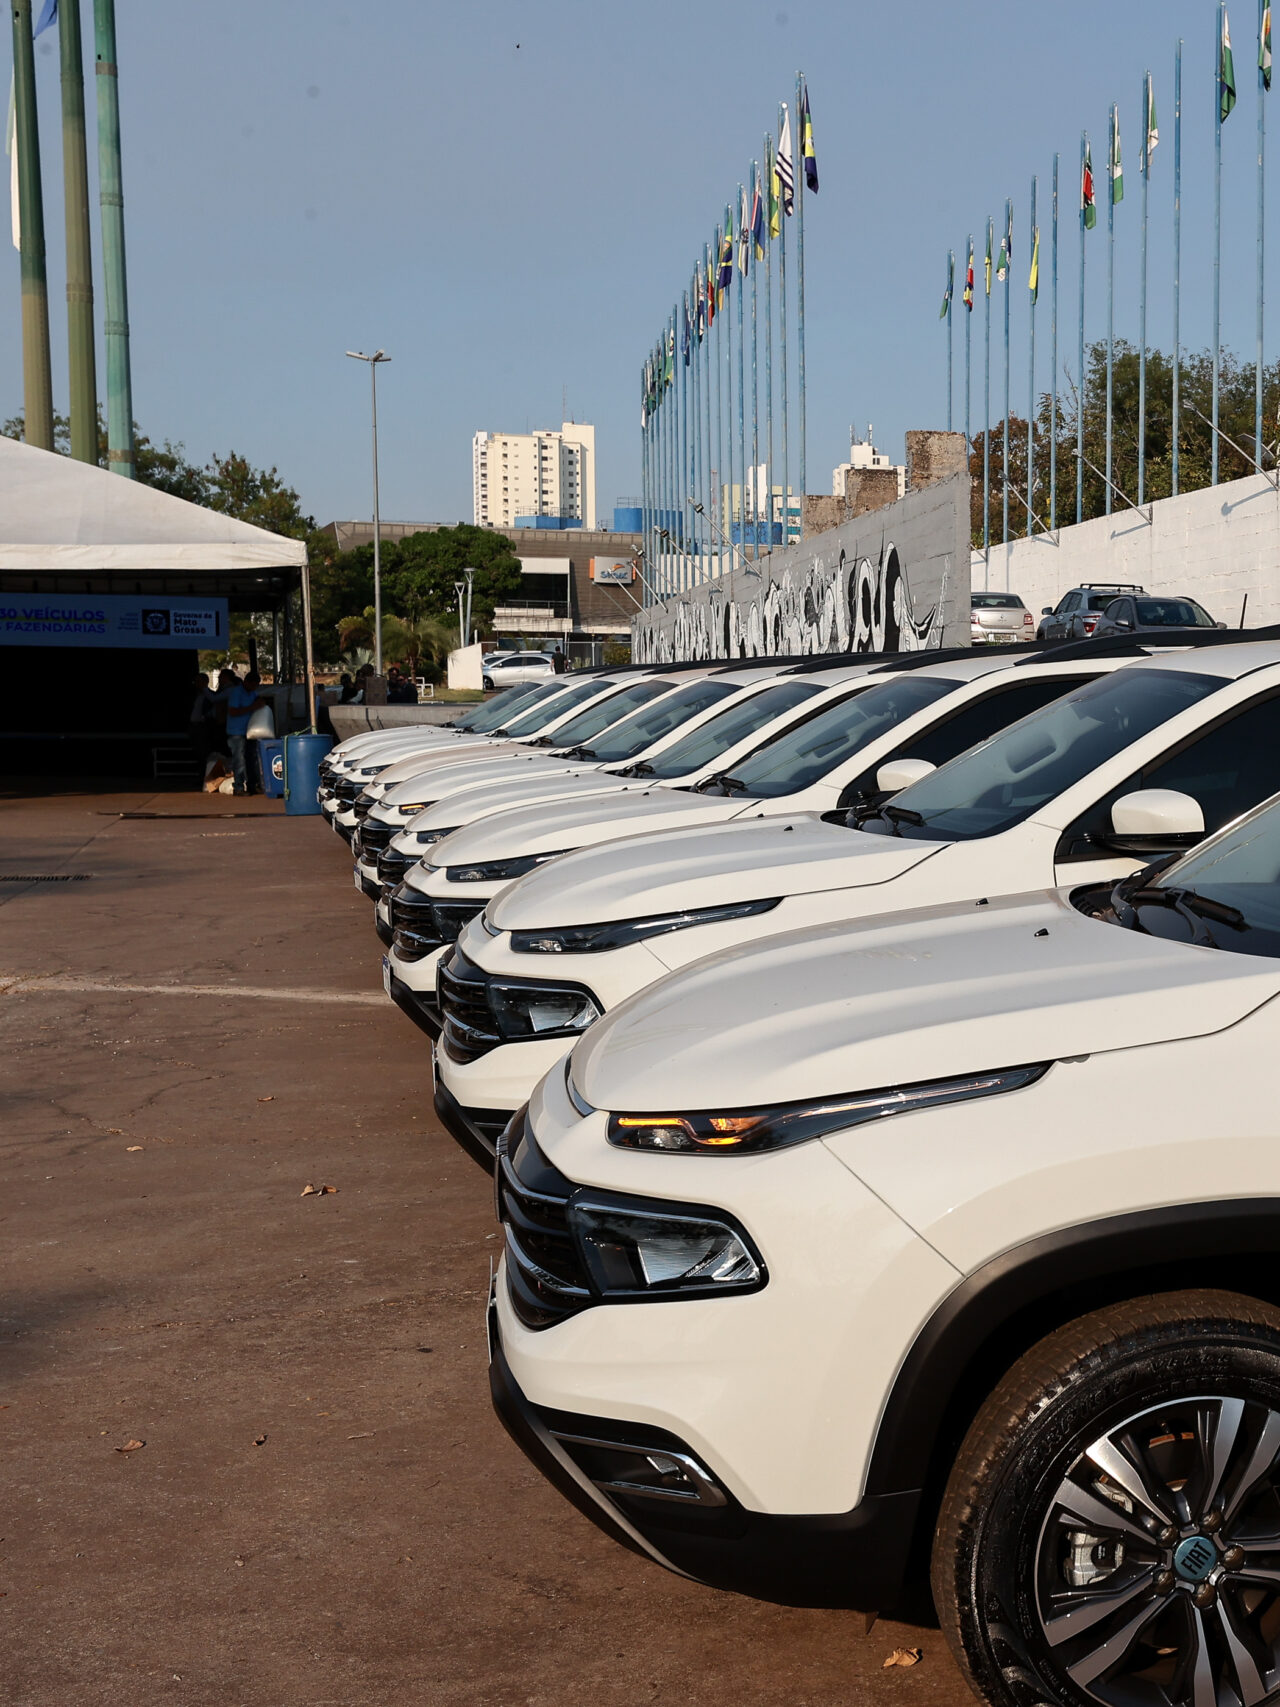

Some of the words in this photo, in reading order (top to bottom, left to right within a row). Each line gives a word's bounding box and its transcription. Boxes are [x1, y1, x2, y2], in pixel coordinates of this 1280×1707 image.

[22, 606, 105, 621] VEÍCULOS
[6, 621, 105, 634] FAZENDÁRIAS
[174, 626, 206, 634] Grosso
[1177, 1541, 1213, 1576] FIAT
